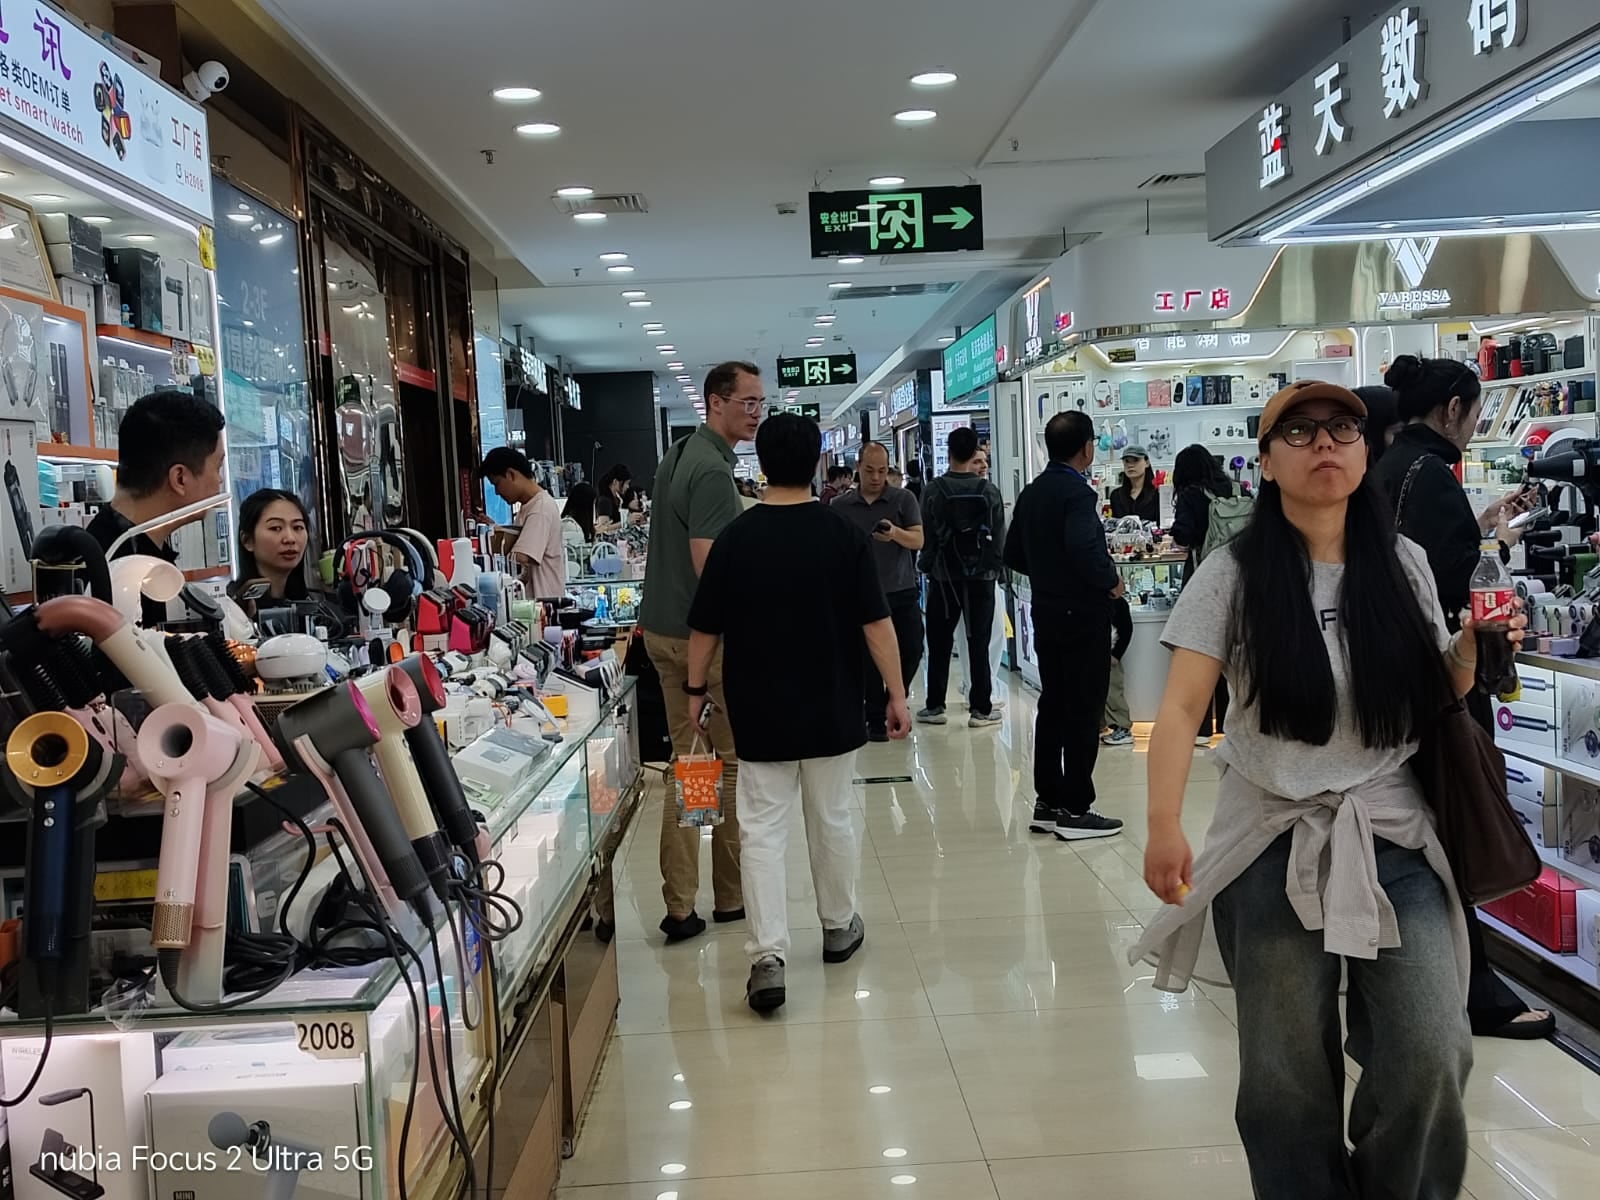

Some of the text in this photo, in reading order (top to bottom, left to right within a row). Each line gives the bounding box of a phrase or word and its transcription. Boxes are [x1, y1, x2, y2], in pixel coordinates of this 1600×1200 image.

[15, 95, 49, 126] smart
[51, 114, 83, 144] watch
[171, 116, 202, 160] 工厂店
[820, 211, 858, 225] 安全出口
[824, 224, 854, 233] EXIT
[1154, 287, 1231, 312] 工厂店
[298, 1022, 355, 1050] 2008
